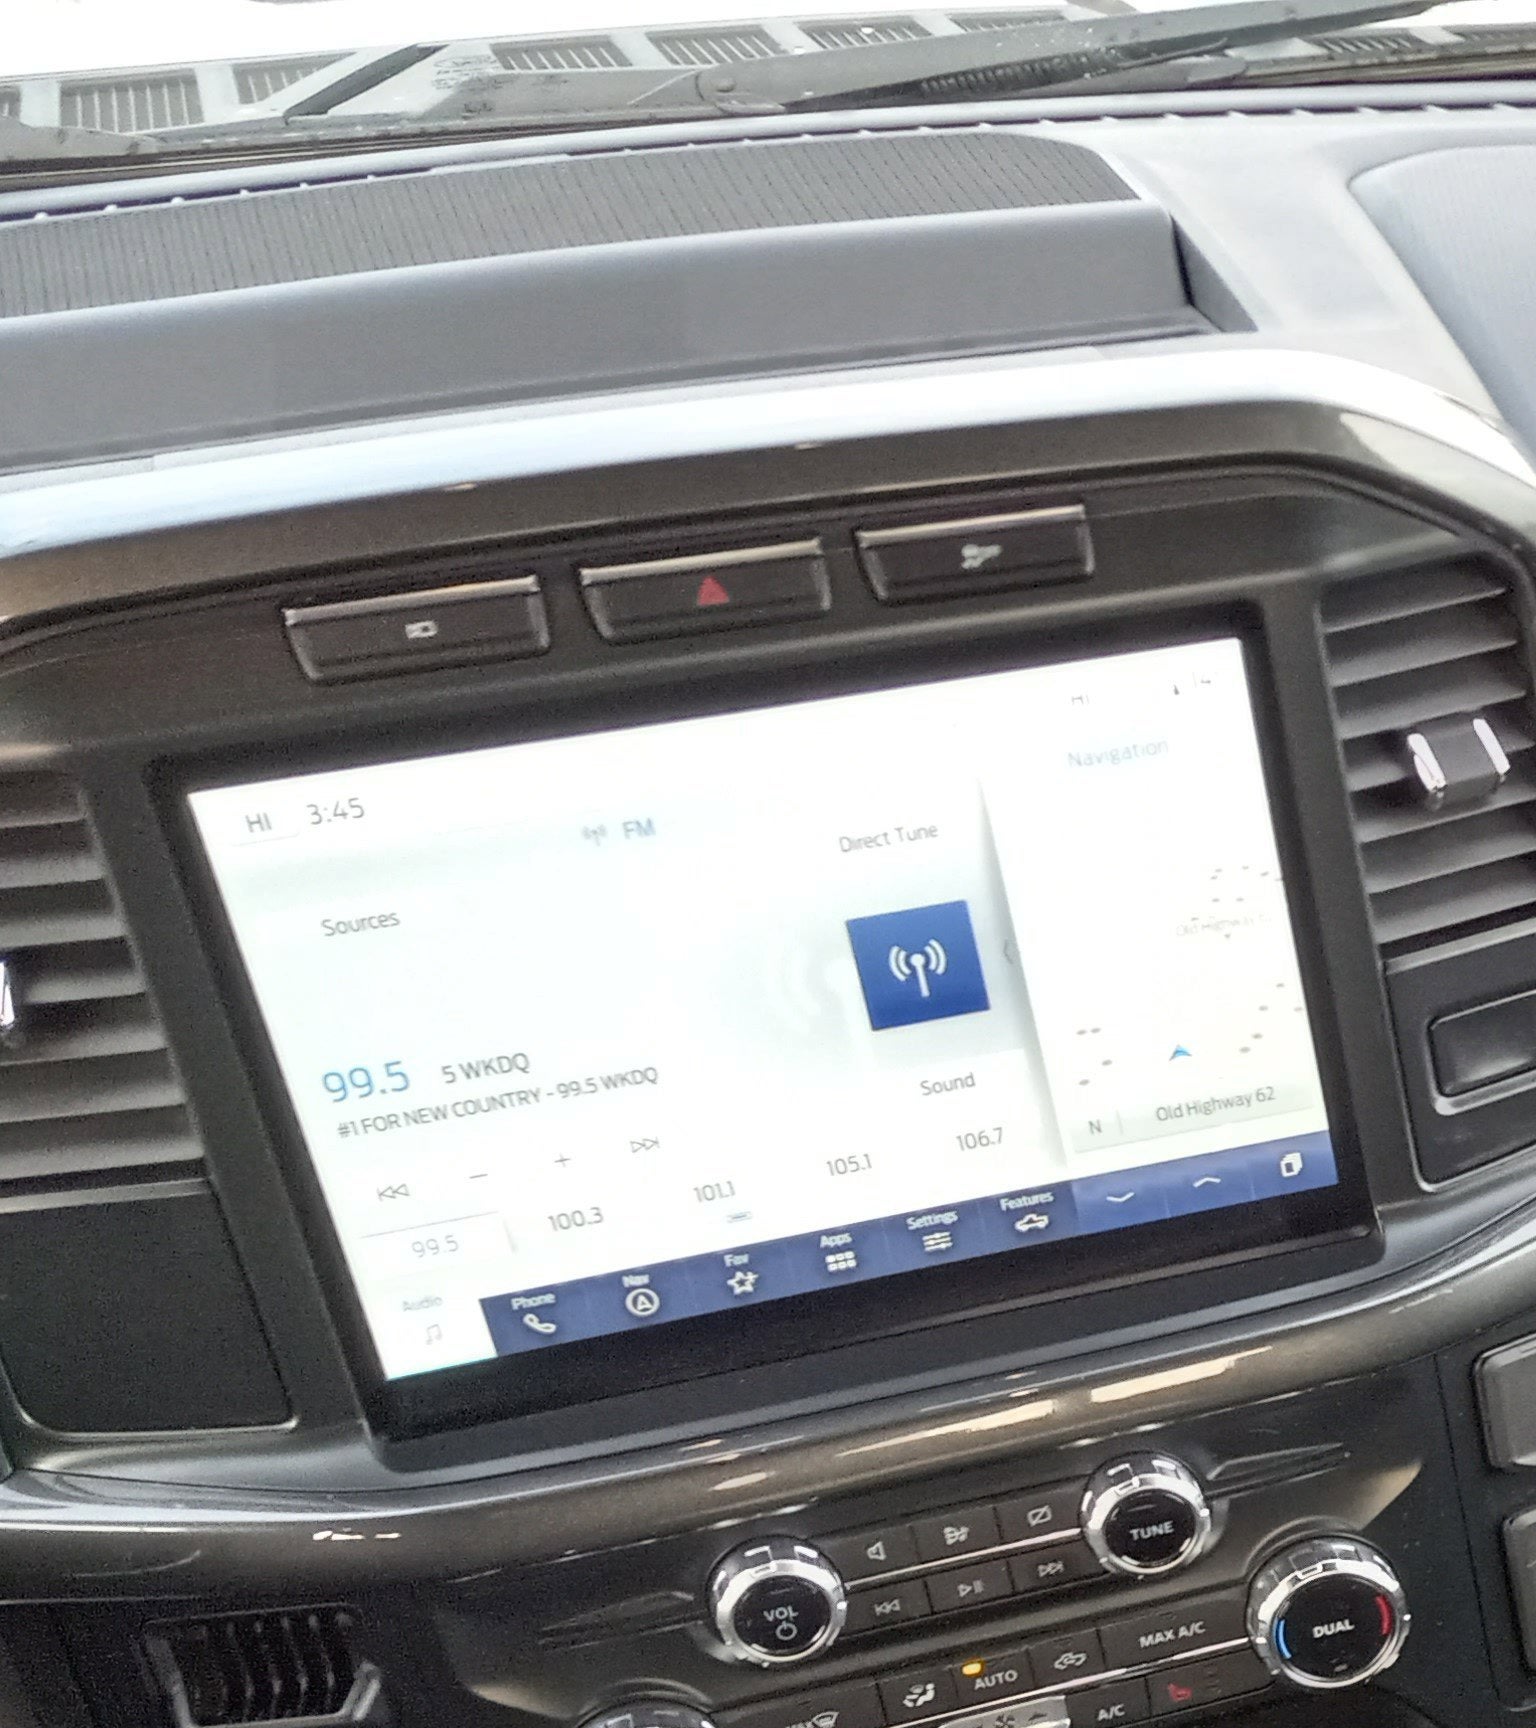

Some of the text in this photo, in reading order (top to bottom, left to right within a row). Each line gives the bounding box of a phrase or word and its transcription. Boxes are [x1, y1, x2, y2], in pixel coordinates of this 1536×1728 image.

[1066, 739, 1169, 768] Navigation
[245, 811, 273, 836] HI
[306, 797, 366, 827] 3:45
[622, 818, 657, 840] FM
[839, 822, 940, 854] Direct Tune
[321, 910, 401, 938] Sources
[459, 1052, 531, 1081] WKDQ
[322, 1060, 411, 1103] 99.5
[920, 1072, 976, 1097] Sound
[361, 1113, 402, 1136] FOR
[403, 1104, 450, 1128] NEW
[451, 1087, 542, 1118] COUNTRY
[556, 1076, 599, 1100] 99.5
[600, 1066, 659, 1092] WKDQ
[1156, 1085, 1276, 1123] Old Highway 62
[1088, 1118, 1103, 1136] N
[411, 1126, 1005, 1260] 99.5 100.3 101.1 105.1 106.7
[511, 1189, 1054, 1312] Phone Nav Fav Apps Settings Features
[402, 1293, 443, 1312] Audio
[1129, 1520, 1175, 1544] TUNE
[762, 1604, 801, 1625] VOL
[1138, 1620, 1207, 1649] MAX A/C
[1311, 1619, 1356, 1640] DUAL
[974, 1669, 1018, 1691] AUTO
[1097, 1703, 1126, 1721] A/C
